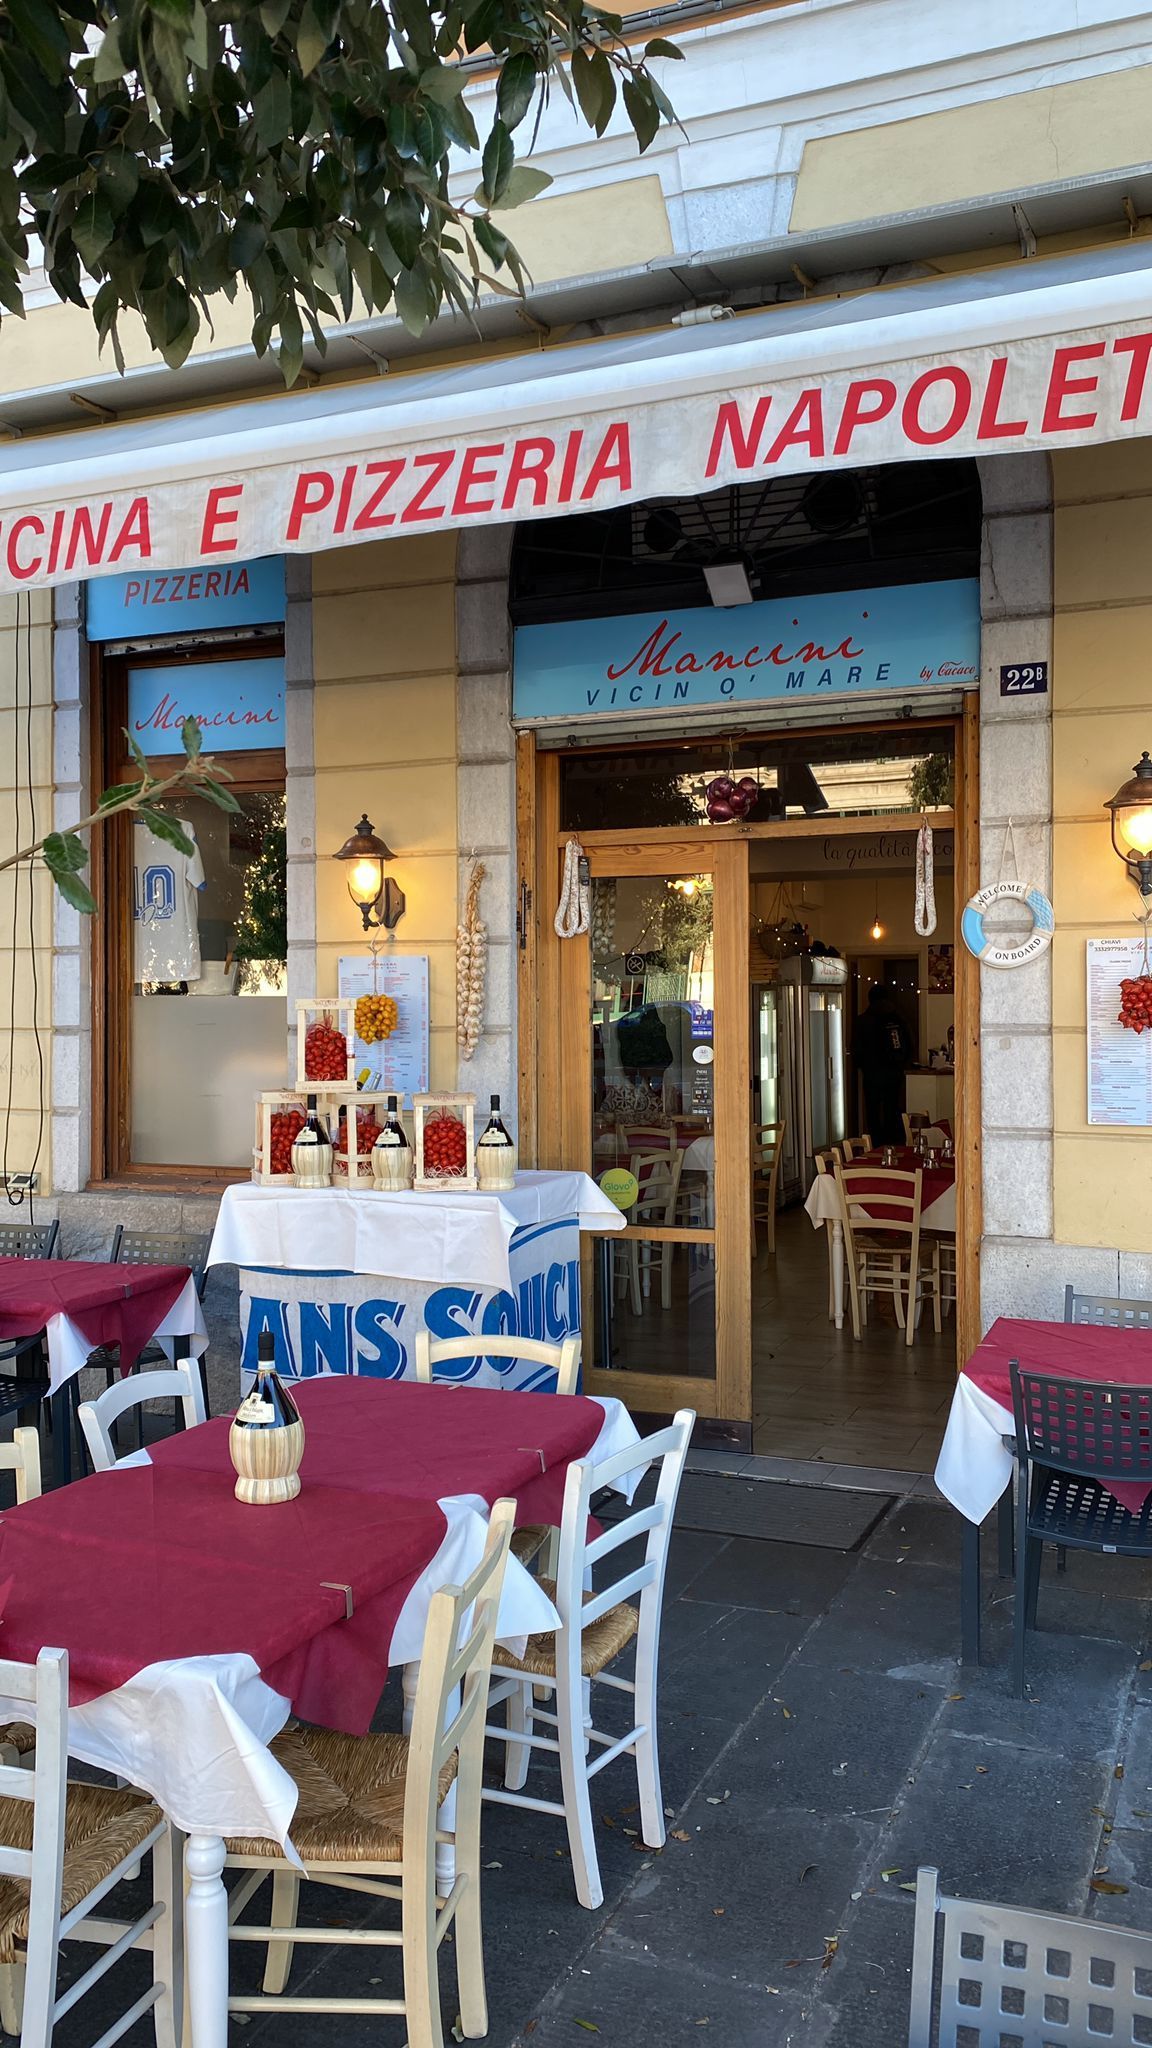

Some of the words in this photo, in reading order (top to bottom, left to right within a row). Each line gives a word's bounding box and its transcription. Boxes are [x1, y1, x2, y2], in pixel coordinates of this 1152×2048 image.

[0, 497, 151, 580] CINA
[200, 484, 243, 554] E
[286, 422, 632, 541] PIZZERIA
[704, 332, 1152, 479] NAPOLET
[125, 569, 249, 608] PIZZERIA
[607, 611, 867, 681] Mancini
[586, 681, 689, 706] VICIN
[785, 663, 891, 689] MARE
[919, 666, 934, 681] by
[135, 692, 280, 731] Mancini
[978, 884, 1022, 906] WELCOME
[994, 951, 1010, 961] ON
[1011, 937, 1041, 960] BOARD
[604, 1182, 632, 1191] Glovo
